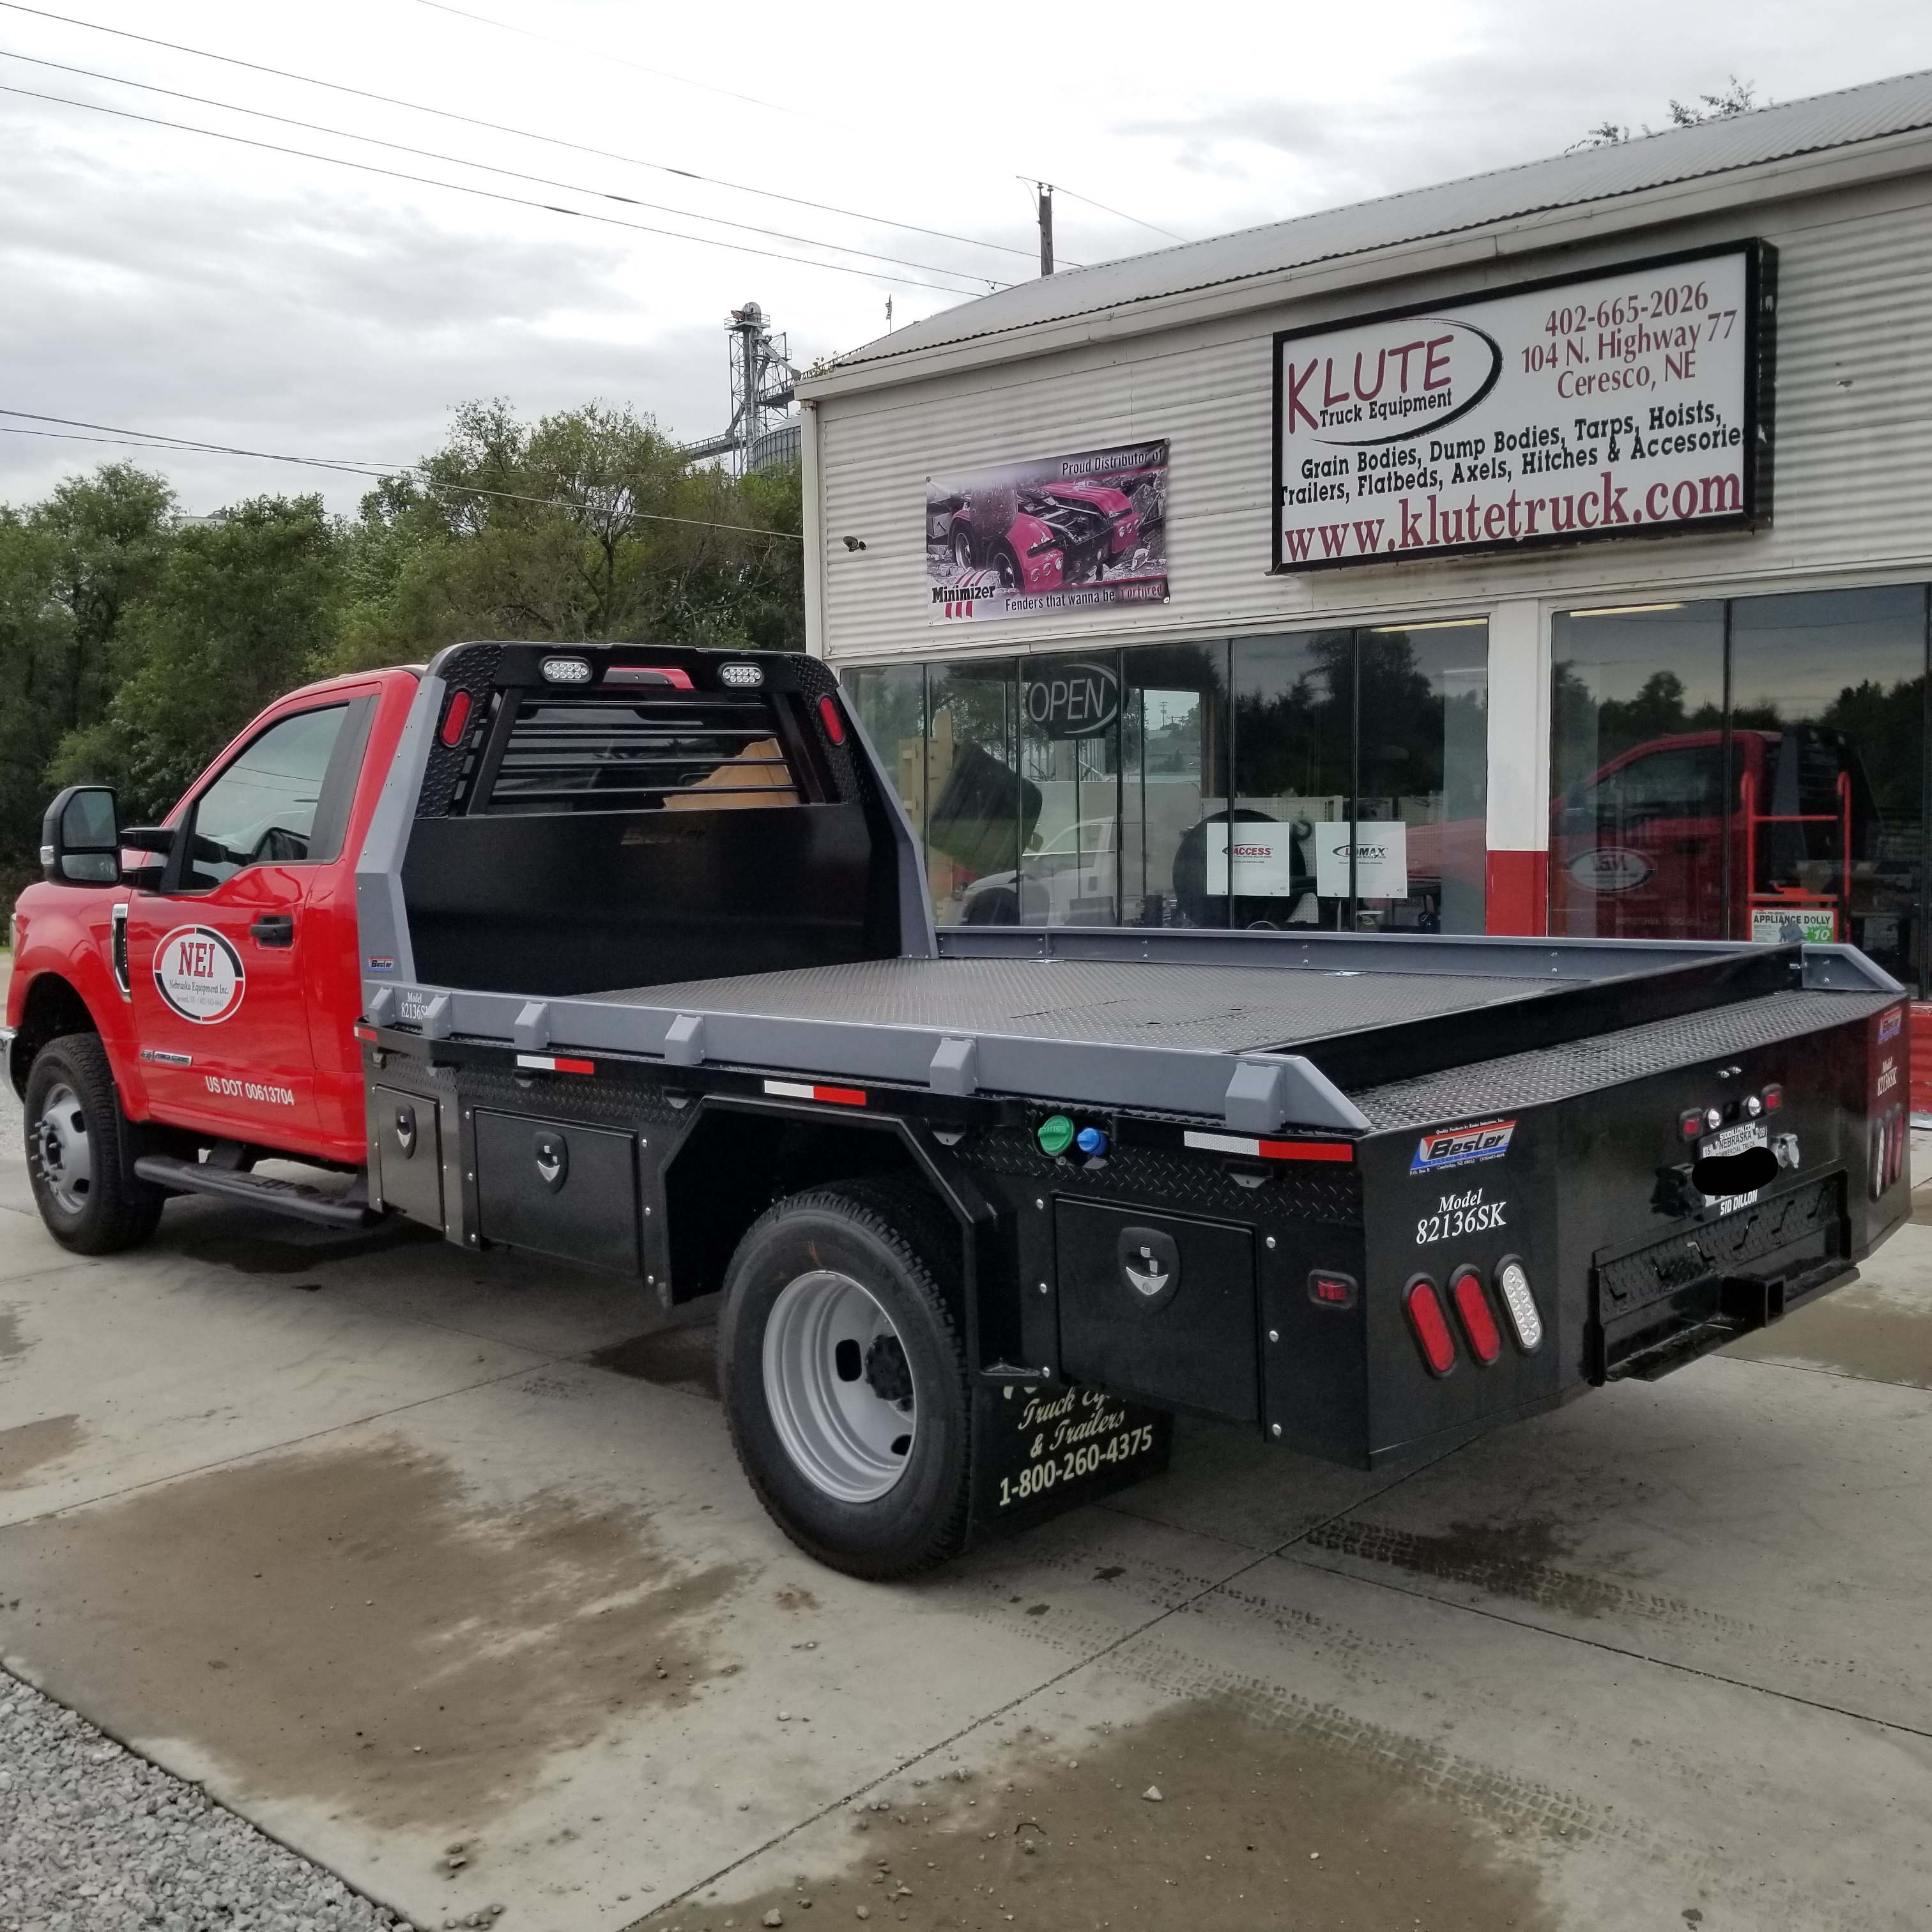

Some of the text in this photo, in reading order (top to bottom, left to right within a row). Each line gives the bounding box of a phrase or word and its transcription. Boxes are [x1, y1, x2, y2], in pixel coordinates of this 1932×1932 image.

[1545, 281, 1709, 337] 402-665-2026
[1522, 309, 1738, 374] 104 N. Highway 77
[1288, 334, 1454, 435] KLUTE
[1557, 349, 1697, 399] Ceresco, NE
[1319, 389, 1453, 428] Truck Equipment
[1301, 400, 1721, 480] Grain Bodies, Dump Bodies, Tarps, Hoists,
[1062, 448, 1163, 476] Proud Distributor of
[1282, 423, 1745, 507] Trailers, Flatbeds, Axels, Hitches & Accesorie
[1284, 470, 1744, 562] www.klutetruck.com
[931, 585, 996, 604] Minimizer
[1006, 583, 1163, 611] Fenders that wanna be Tortured
[1029, 677, 1105, 722] OPEN
[1234, 847, 1271, 855] ACCESS
[1344, 847, 1386, 856] LMAX
[1753, 915, 1831, 924] APPLIANCE DOLLY
[178, 941, 215, 978] NEI
[169, 979, 229, 995] Nebraska Equipment Inc.
[407, 992, 422, 1004] Model
[401, 1002, 428, 1020] 82136S
[205, 1075, 295, 1106] US DOT 00613704
[1427, 1131, 1506, 1161] Besler
[1718, 1131, 1752, 1150] NEBRASKA
[1719, 1122, 1756, 1140] SIDDILLON.COM
[1742, 1141, 1756, 1150] TRUCK
[1705, 1146, 1711, 1156] 15
[1437, 1188, 1483, 1214] Model
[1720, 1189, 1758, 1216] SID DILLON
[1415, 1201, 1507, 1245] 82136SK
[1017, 1386, 1076, 1430] Truck
[1029, 1407, 1125, 1459] & Trailers
[999, 1424, 1153, 1506] 1-800-260-4375
